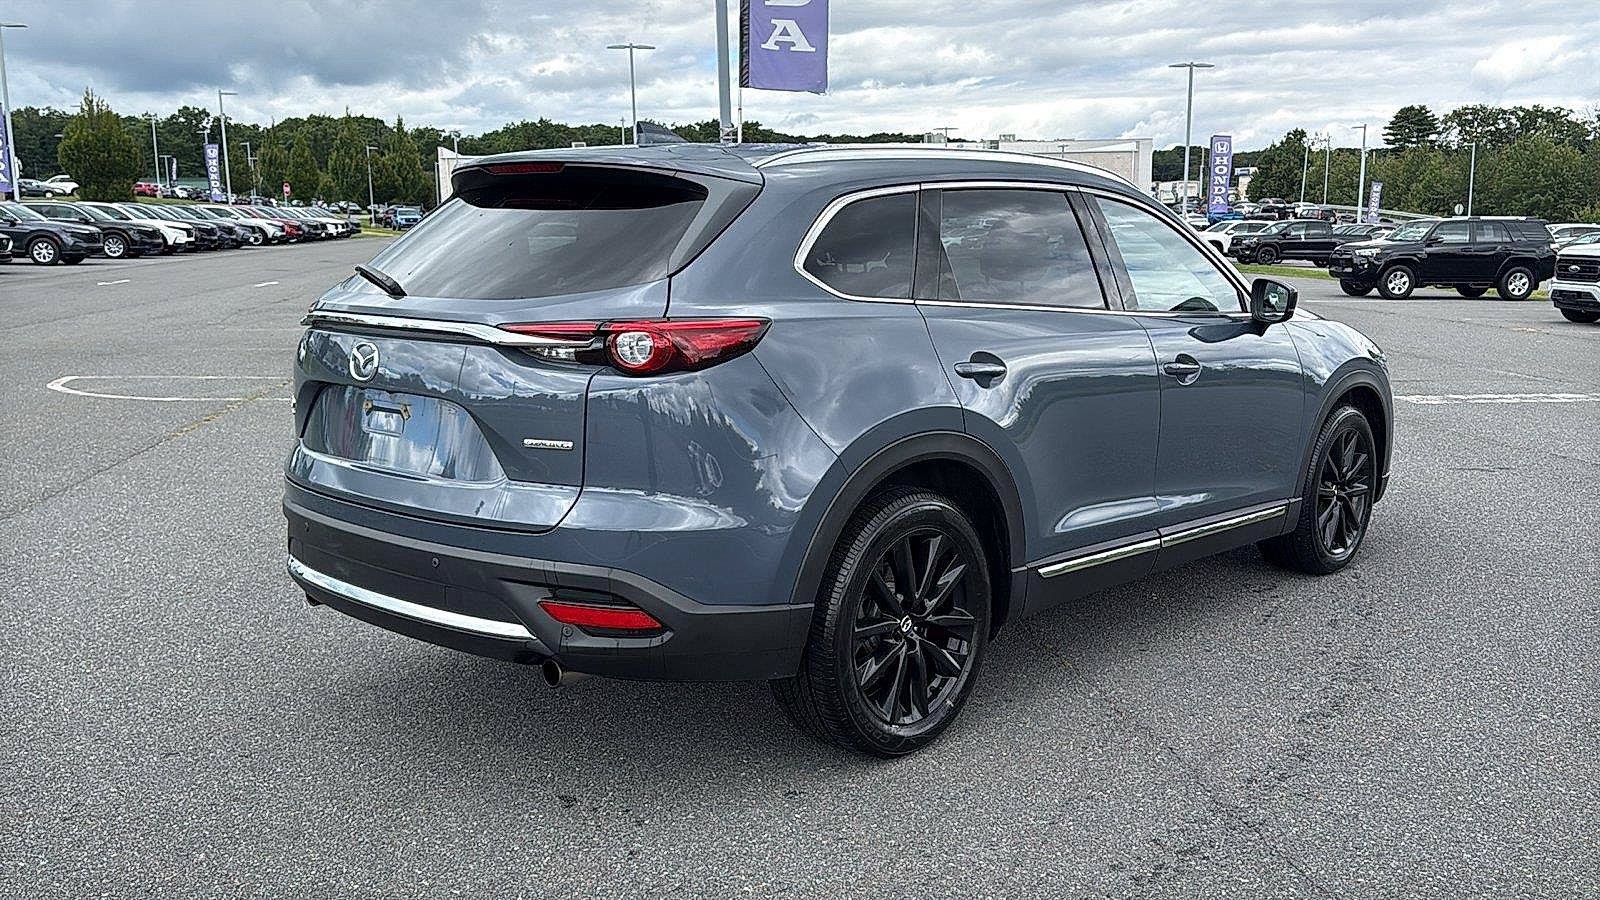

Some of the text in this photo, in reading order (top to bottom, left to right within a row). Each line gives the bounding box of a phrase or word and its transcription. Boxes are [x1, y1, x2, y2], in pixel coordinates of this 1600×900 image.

[761, 0, 816, 52] A
[208, 159, 221, 195] HONDA
[1212, 156, 1229, 205] HONDA
